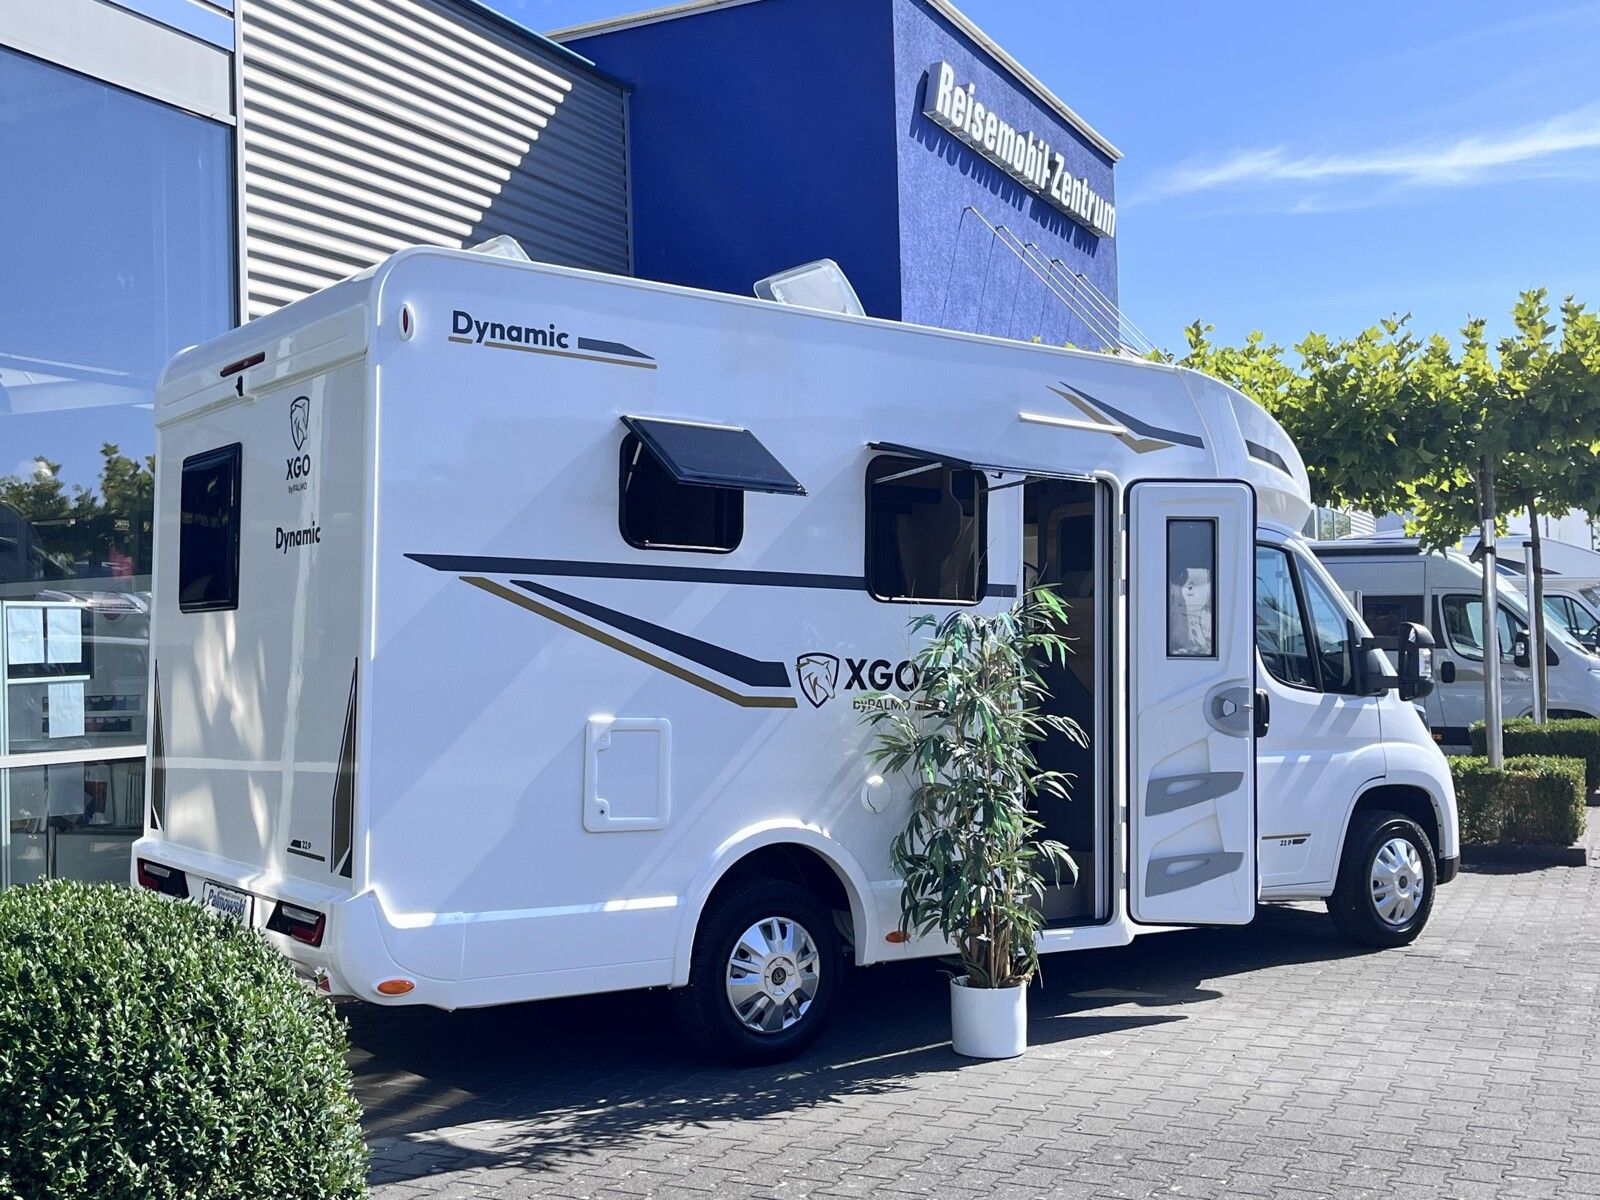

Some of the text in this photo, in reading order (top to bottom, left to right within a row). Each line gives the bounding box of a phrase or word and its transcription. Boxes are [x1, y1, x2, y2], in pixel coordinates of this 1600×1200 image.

[936, 60, 1116, 238] Reisemobil-Zentrum
[452, 309, 570, 349] Dynamic
[286, 454, 311, 481] XGO
[275, 520, 322, 554] Dynamic
[844, 658, 920, 692] XGO
